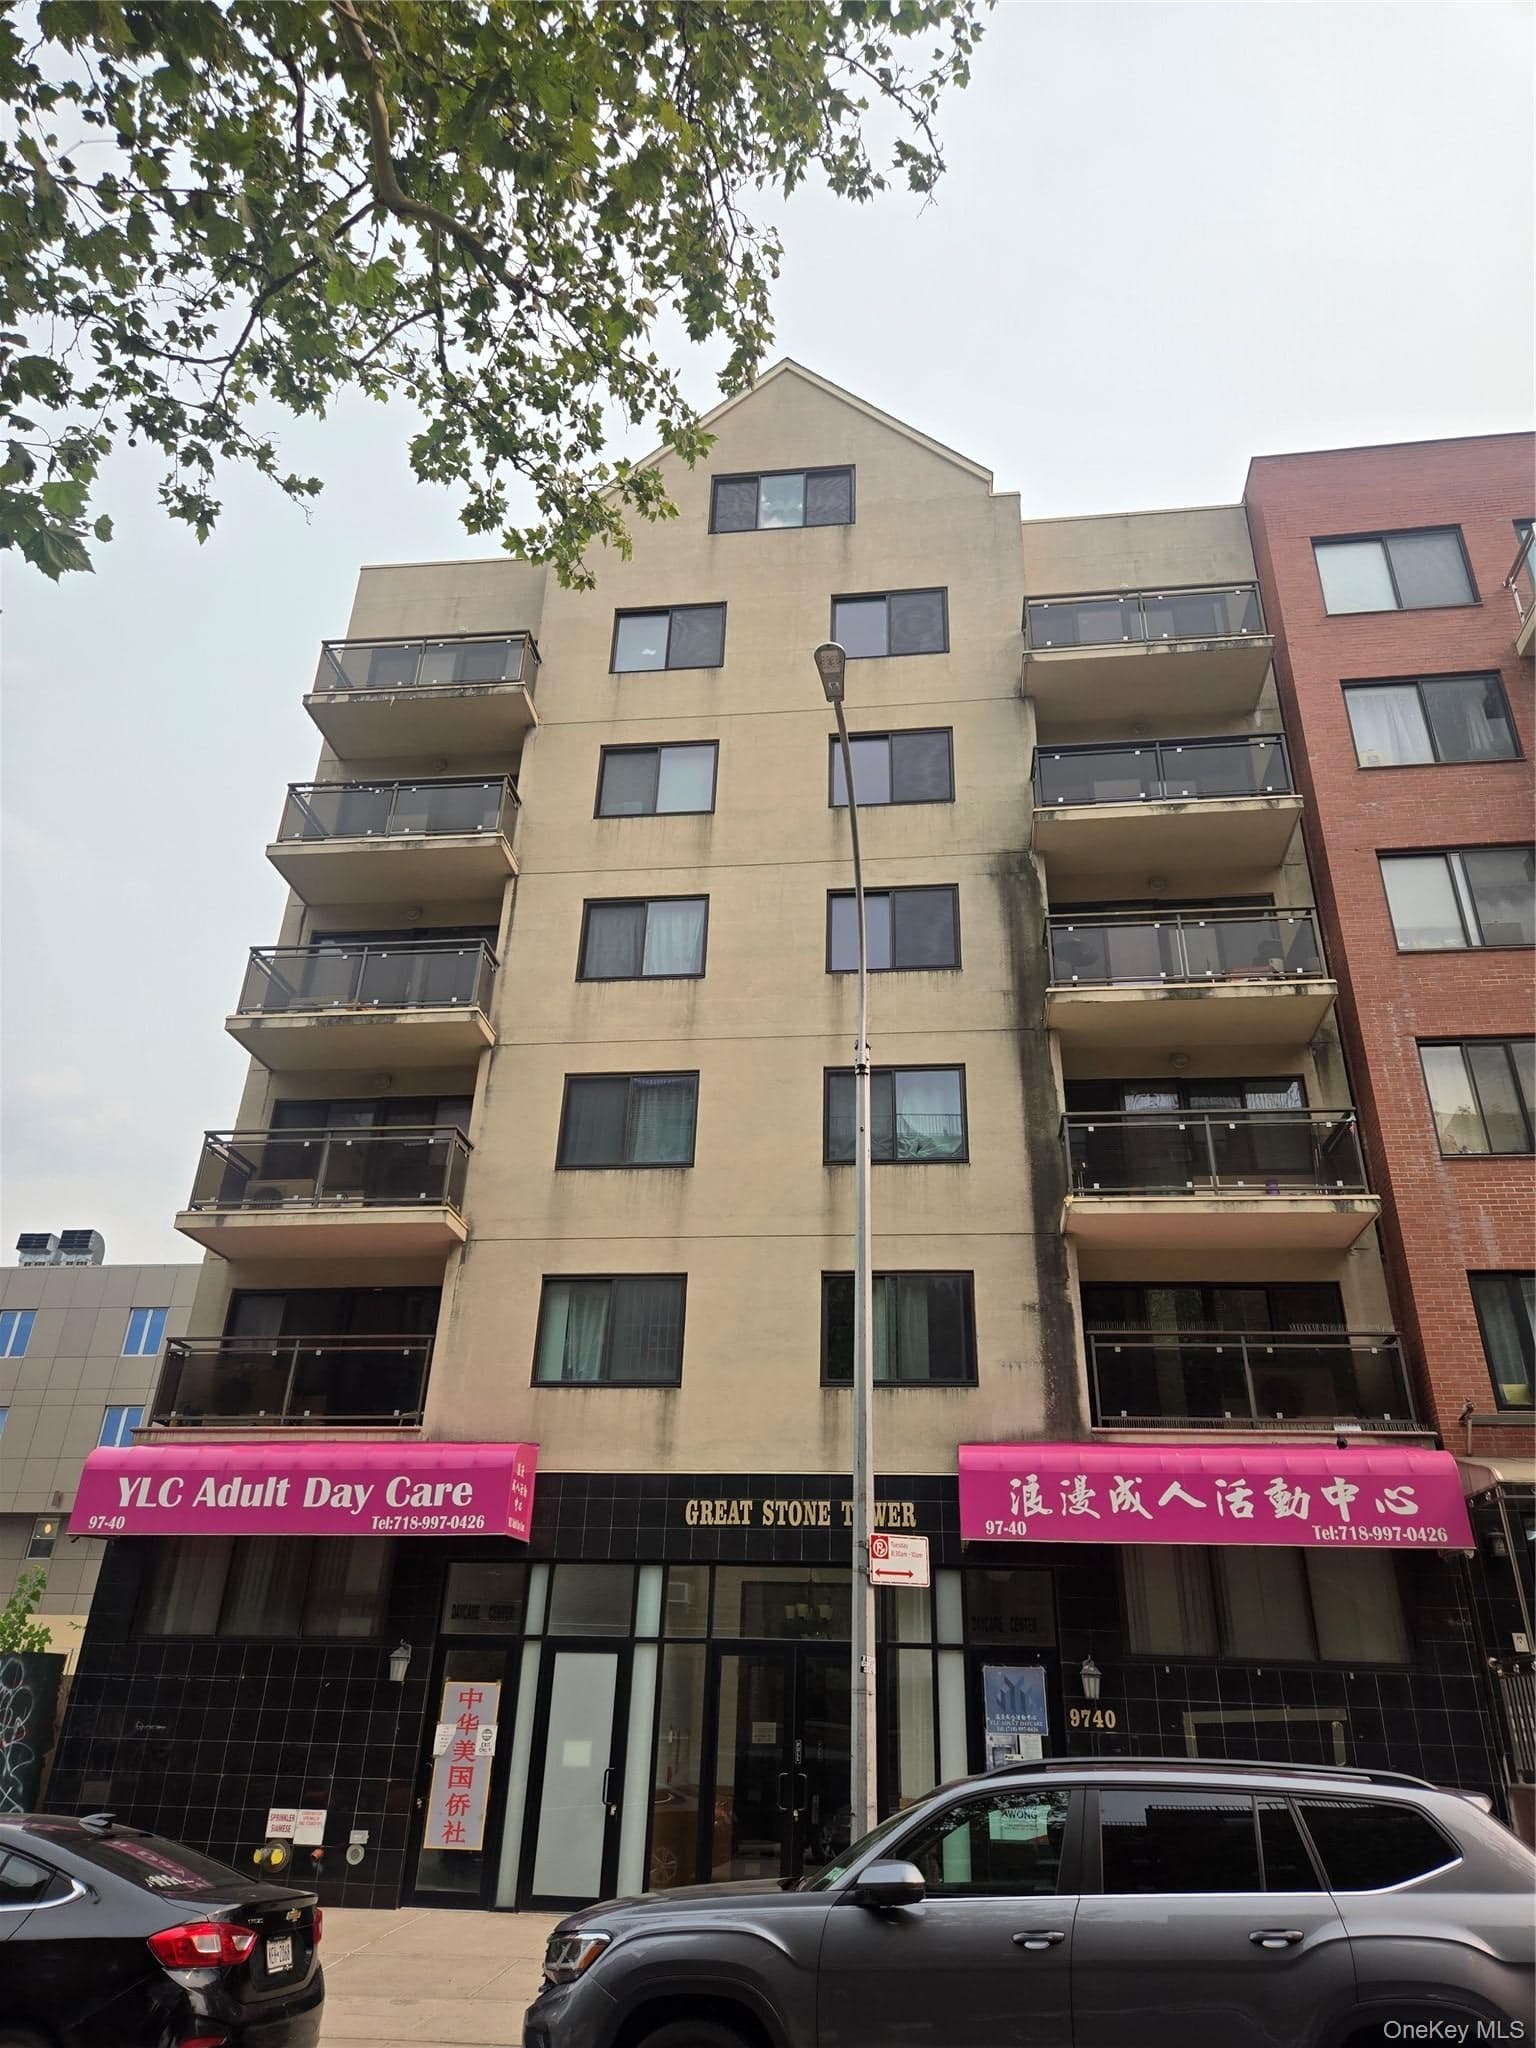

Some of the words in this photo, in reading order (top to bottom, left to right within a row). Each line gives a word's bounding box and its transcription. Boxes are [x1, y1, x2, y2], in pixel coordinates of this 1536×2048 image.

[119, 1477, 184, 1508] YLC
[192, 1476, 291, 1508] Adult
[303, 1477, 375, 1515] Day
[385, 1476, 473, 1508] Care
[1009, 1473, 1419, 1522] 浪漫成人活動中心
[371, 1514, 486, 1530] Tel:718-997-0426
[685, 1499, 752, 1526] GREAT
[762, 1500, 831, 1526] STONE
[841, 1501, 917, 1528] TWER
[88, 1515, 126, 1530] 97-40
[985, 1520, 1027, 1536] 97-40
[1311, 1525, 1448, 1542] Tel:718-997-0426
[1069, 1708, 1117, 1729] 9740
[441, 1687, 484, 1845] 中华美国侨社
[270, 1813, 296, 1823] SPRINKLER
[270, 1824, 292, 1834] SIAMESE
